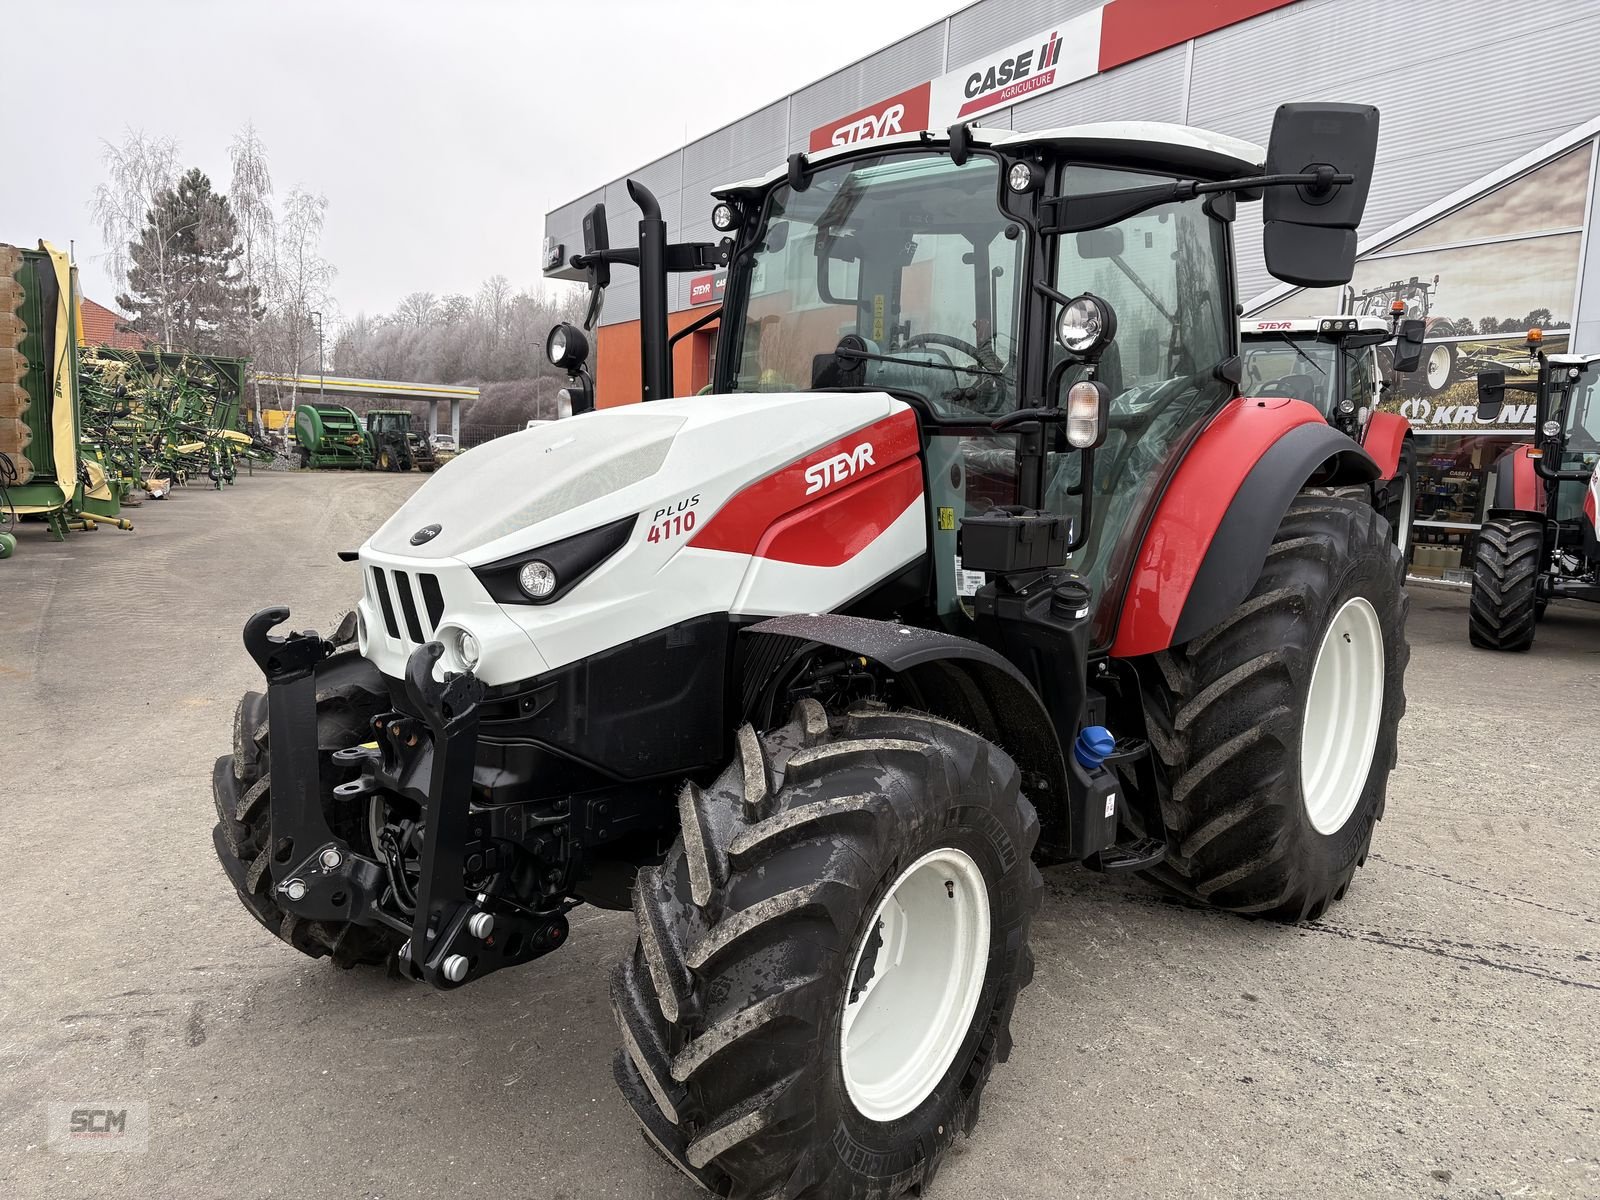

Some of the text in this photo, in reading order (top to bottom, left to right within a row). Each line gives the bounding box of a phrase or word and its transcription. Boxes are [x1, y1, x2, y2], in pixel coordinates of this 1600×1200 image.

[964, 49, 1034, 99] CASE
[1000, 73, 1052, 100] AGRICULTURE
[831, 103, 905, 146] STEYR
[692, 283, 711, 297] STEYR
[715, 278, 727, 288] CAS
[1257, 322, 1292, 330] STEYR
[804, 442, 876, 496] STEYR
[653, 494, 700, 522] PLUS
[647, 511, 696, 544] 4110
